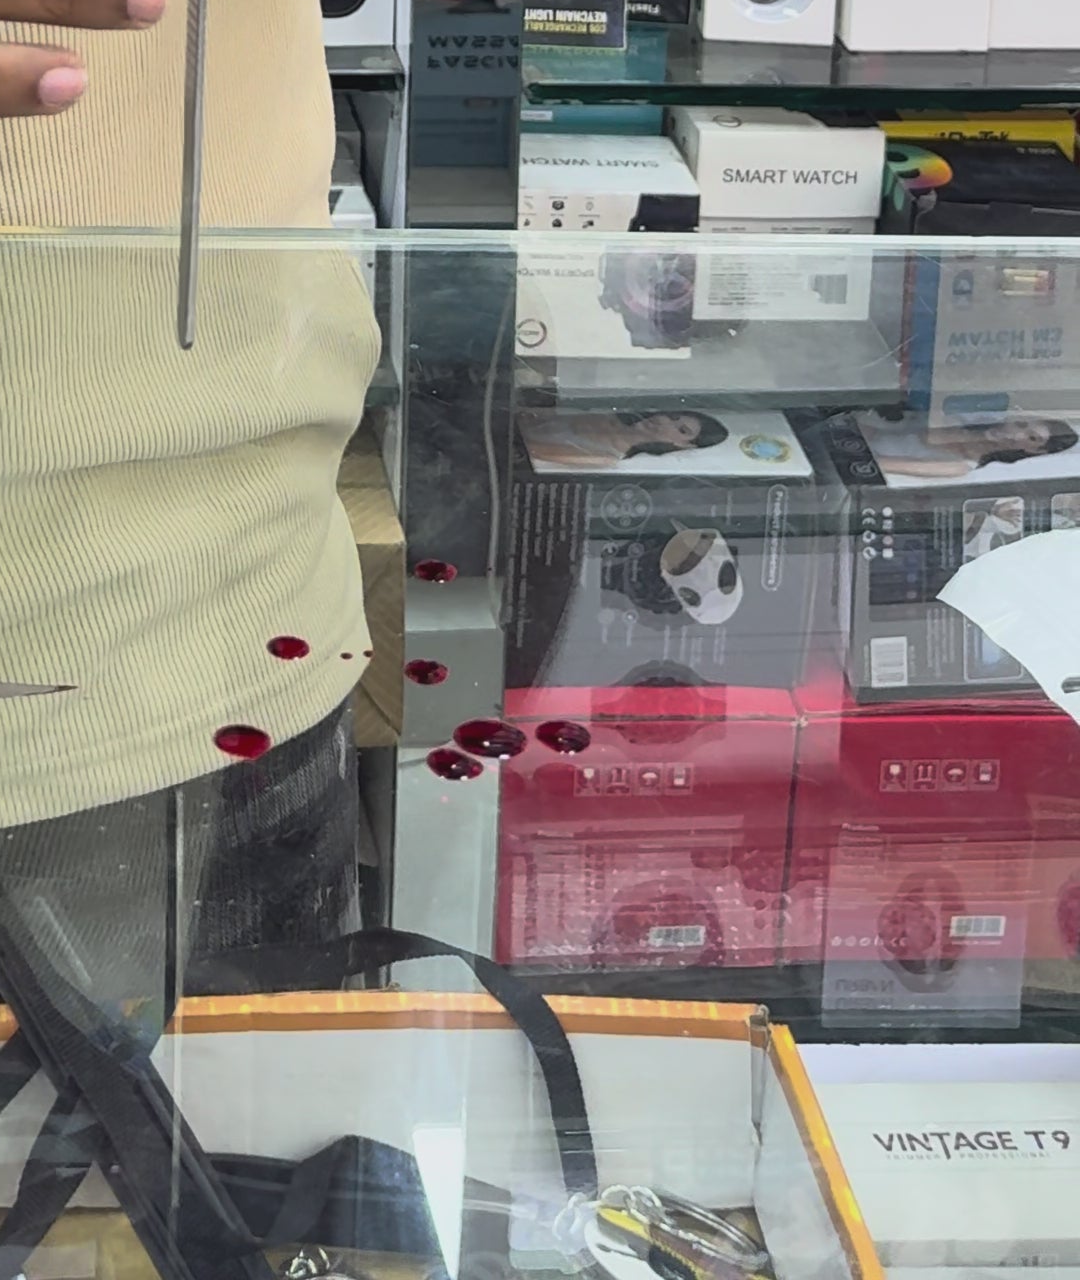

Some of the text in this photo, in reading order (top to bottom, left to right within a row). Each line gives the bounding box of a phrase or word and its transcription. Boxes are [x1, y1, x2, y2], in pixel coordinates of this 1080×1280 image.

[524, 8, 608, 23] KEYCHAIN LIGHT
[522, 156, 659, 168] SMART WATCH
[722, 169, 857, 186] SMART WATCH
[873, 1130, 1018, 1160] VINTAGE
